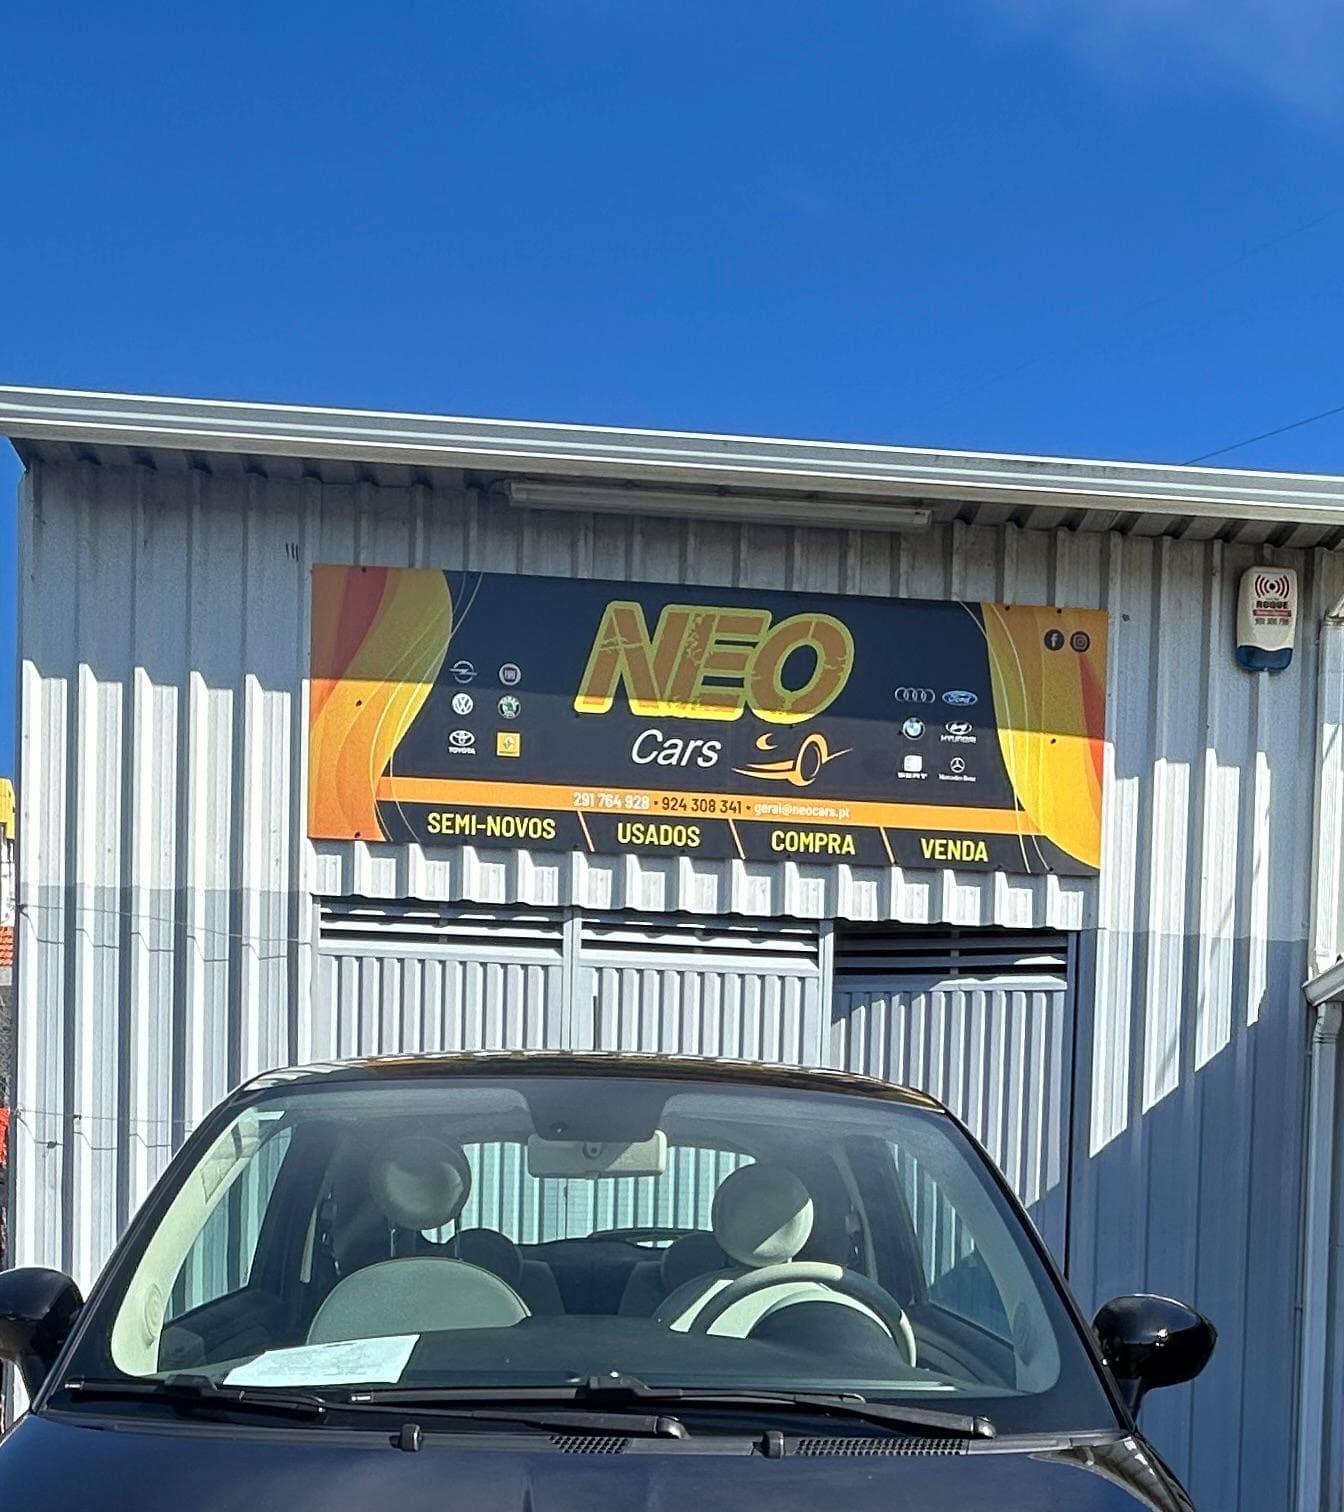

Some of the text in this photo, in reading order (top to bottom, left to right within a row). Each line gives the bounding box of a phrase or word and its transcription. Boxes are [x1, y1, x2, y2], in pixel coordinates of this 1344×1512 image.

[574, 601, 854, 724] NEO
[631, 729, 722, 767] Cars
[573, 791, 849, 819] 291 764 928 924 308 341 geral@neocars.pt
[427, 813, 556, 840] SEMI-NOVOS
[617, 823, 701, 847] USADOS
[771, 830, 856, 855] COMPRA
[921, 838, 989, 862] VENDA
